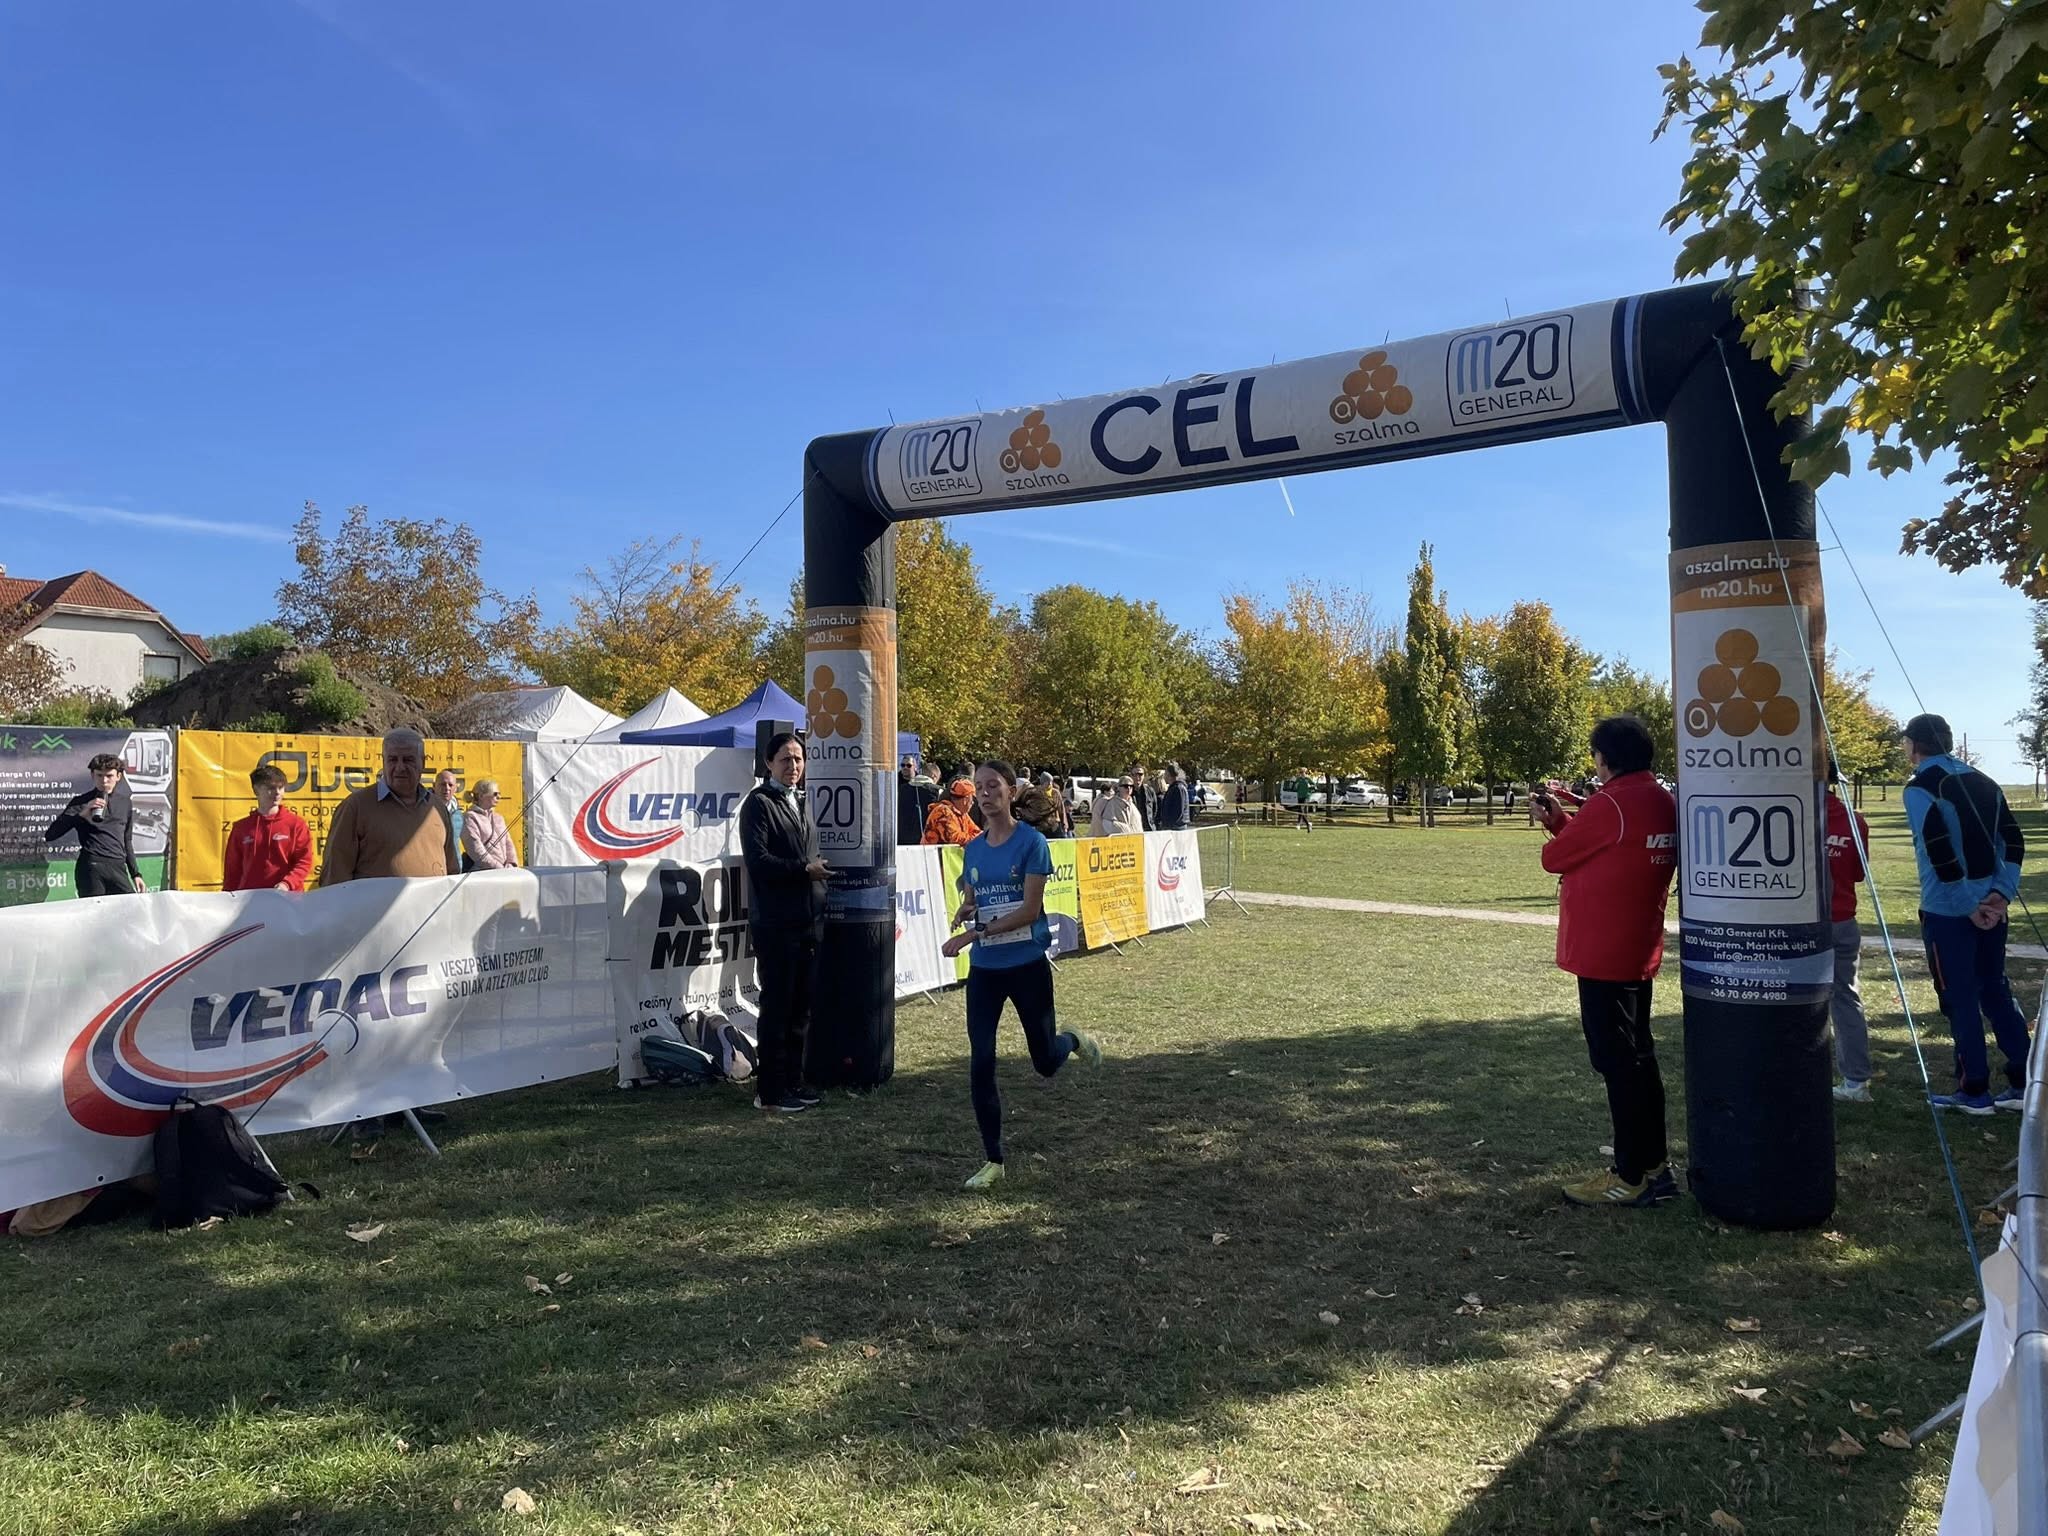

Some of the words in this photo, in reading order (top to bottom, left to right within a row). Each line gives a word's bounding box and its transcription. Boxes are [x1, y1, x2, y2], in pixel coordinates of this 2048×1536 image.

[1457, 322, 1560, 395] m20
[1459, 387, 1563, 416] GENERÁL
[1090, 374, 1300, 475] CÉL
[1334, 420, 1420, 445] szalma
[906, 427, 971, 478] m20
[910, 476, 975, 495] GENERÁL
[1006, 473, 1070, 491] szalma
[1685, 552, 1790, 576] aszalma.hu
[1700, 579, 1773, 599] m20.hu
[808, 630, 843, 644] m20.hu
[806, 740, 863, 760] zalma
[1685, 740, 1803, 768] szalma
[628, 792, 740, 822] VEDAC
[1693, 805, 1795, 868] m20
[20, 872, 67, 892] jövőt!
[1695, 871, 1796, 889] GENERÁL
[989, 895, 1010, 904] CLUB
[1705, 927, 1724, 936] m20
[1726, 928, 1766, 938] Generál
[1768, 929, 1789, 938] Kft.
[1746, 940, 1790, 950] Mártírok
[440, 953, 501, 977] VESZPRÉMI
[503, 947, 544, 969] EGYETEMI
[1713, 951, 1779, 962] info@m20.hu
[446, 980, 459, 999] ÉS
[461, 976, 483, 997] DIÁK
[485, 970, 526, 993] ATLÉTIKAI
[528, 965, 549, 983] CLUB
[1727, 977, 1739, 986] 30
[1742, 979, 1760, 987] 477
[1762, 980, 1786, 988] 8855
[1728, 989, 1739, 999] 70
[1742, 991, 1760, 1000] 699
[1762, 991, 1787, 1001] 4980
[190, 964, 428, 1051] VEDAC
